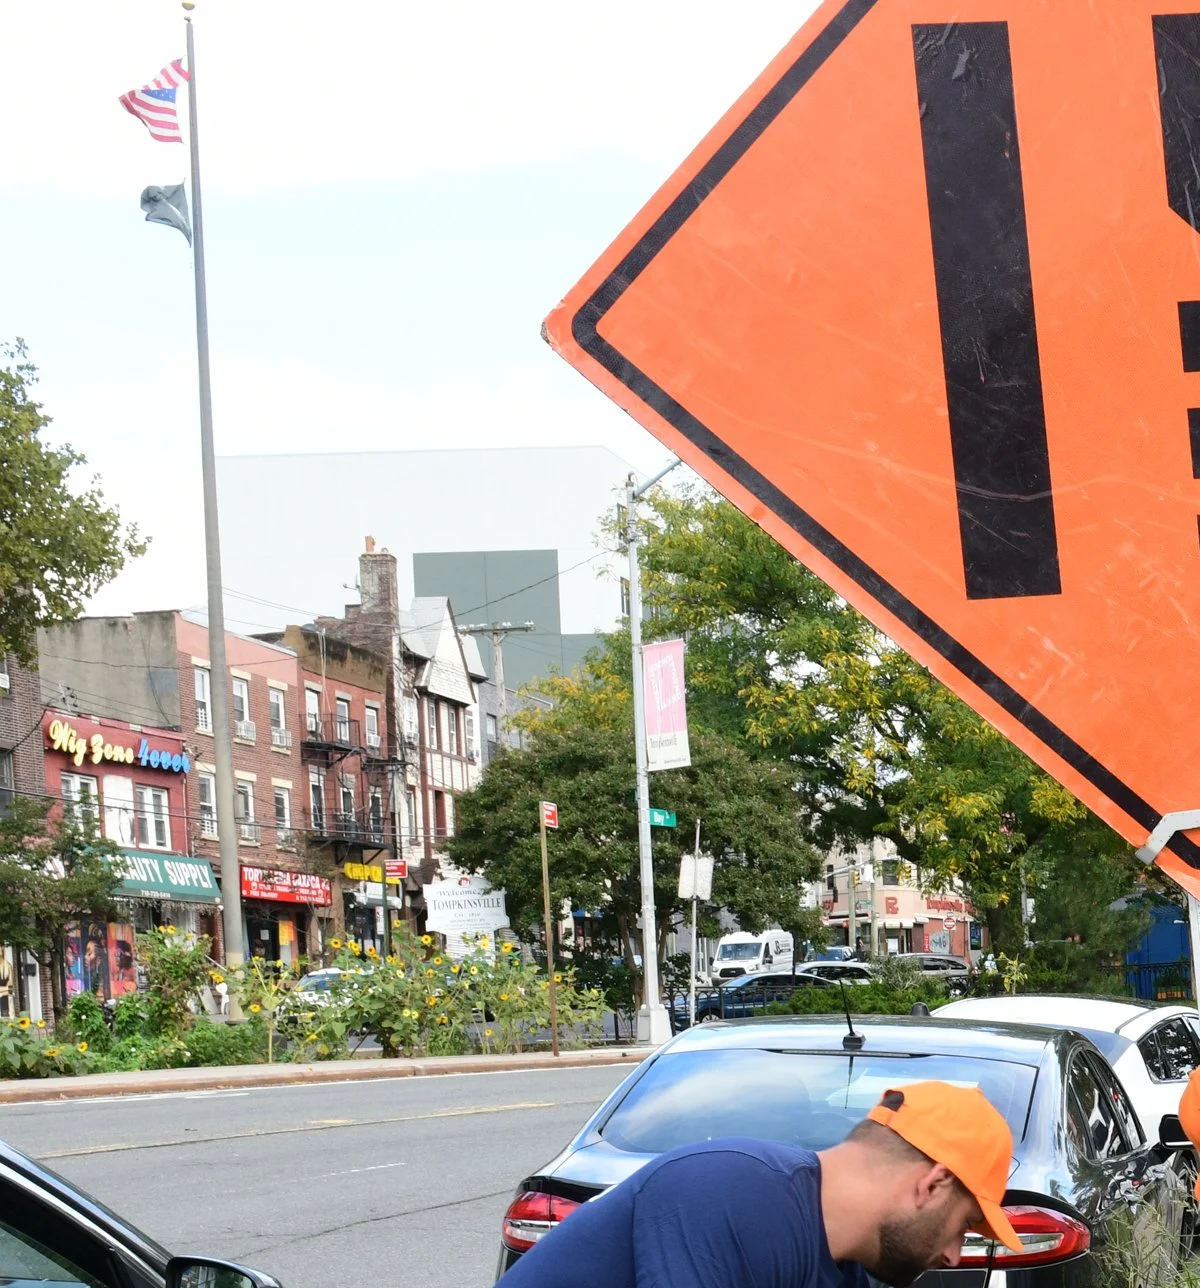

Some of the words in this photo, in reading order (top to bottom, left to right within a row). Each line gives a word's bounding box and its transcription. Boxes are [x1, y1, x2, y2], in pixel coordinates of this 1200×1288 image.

[50, 719, 87, 767] Wig
[91, 734, 134, 764] Zone
[163, 860, 213, 889] SUPPLY
[439, 889, 478, 897] Welcome
[433, 897, 502, 911] TOMPKINSVILLE
